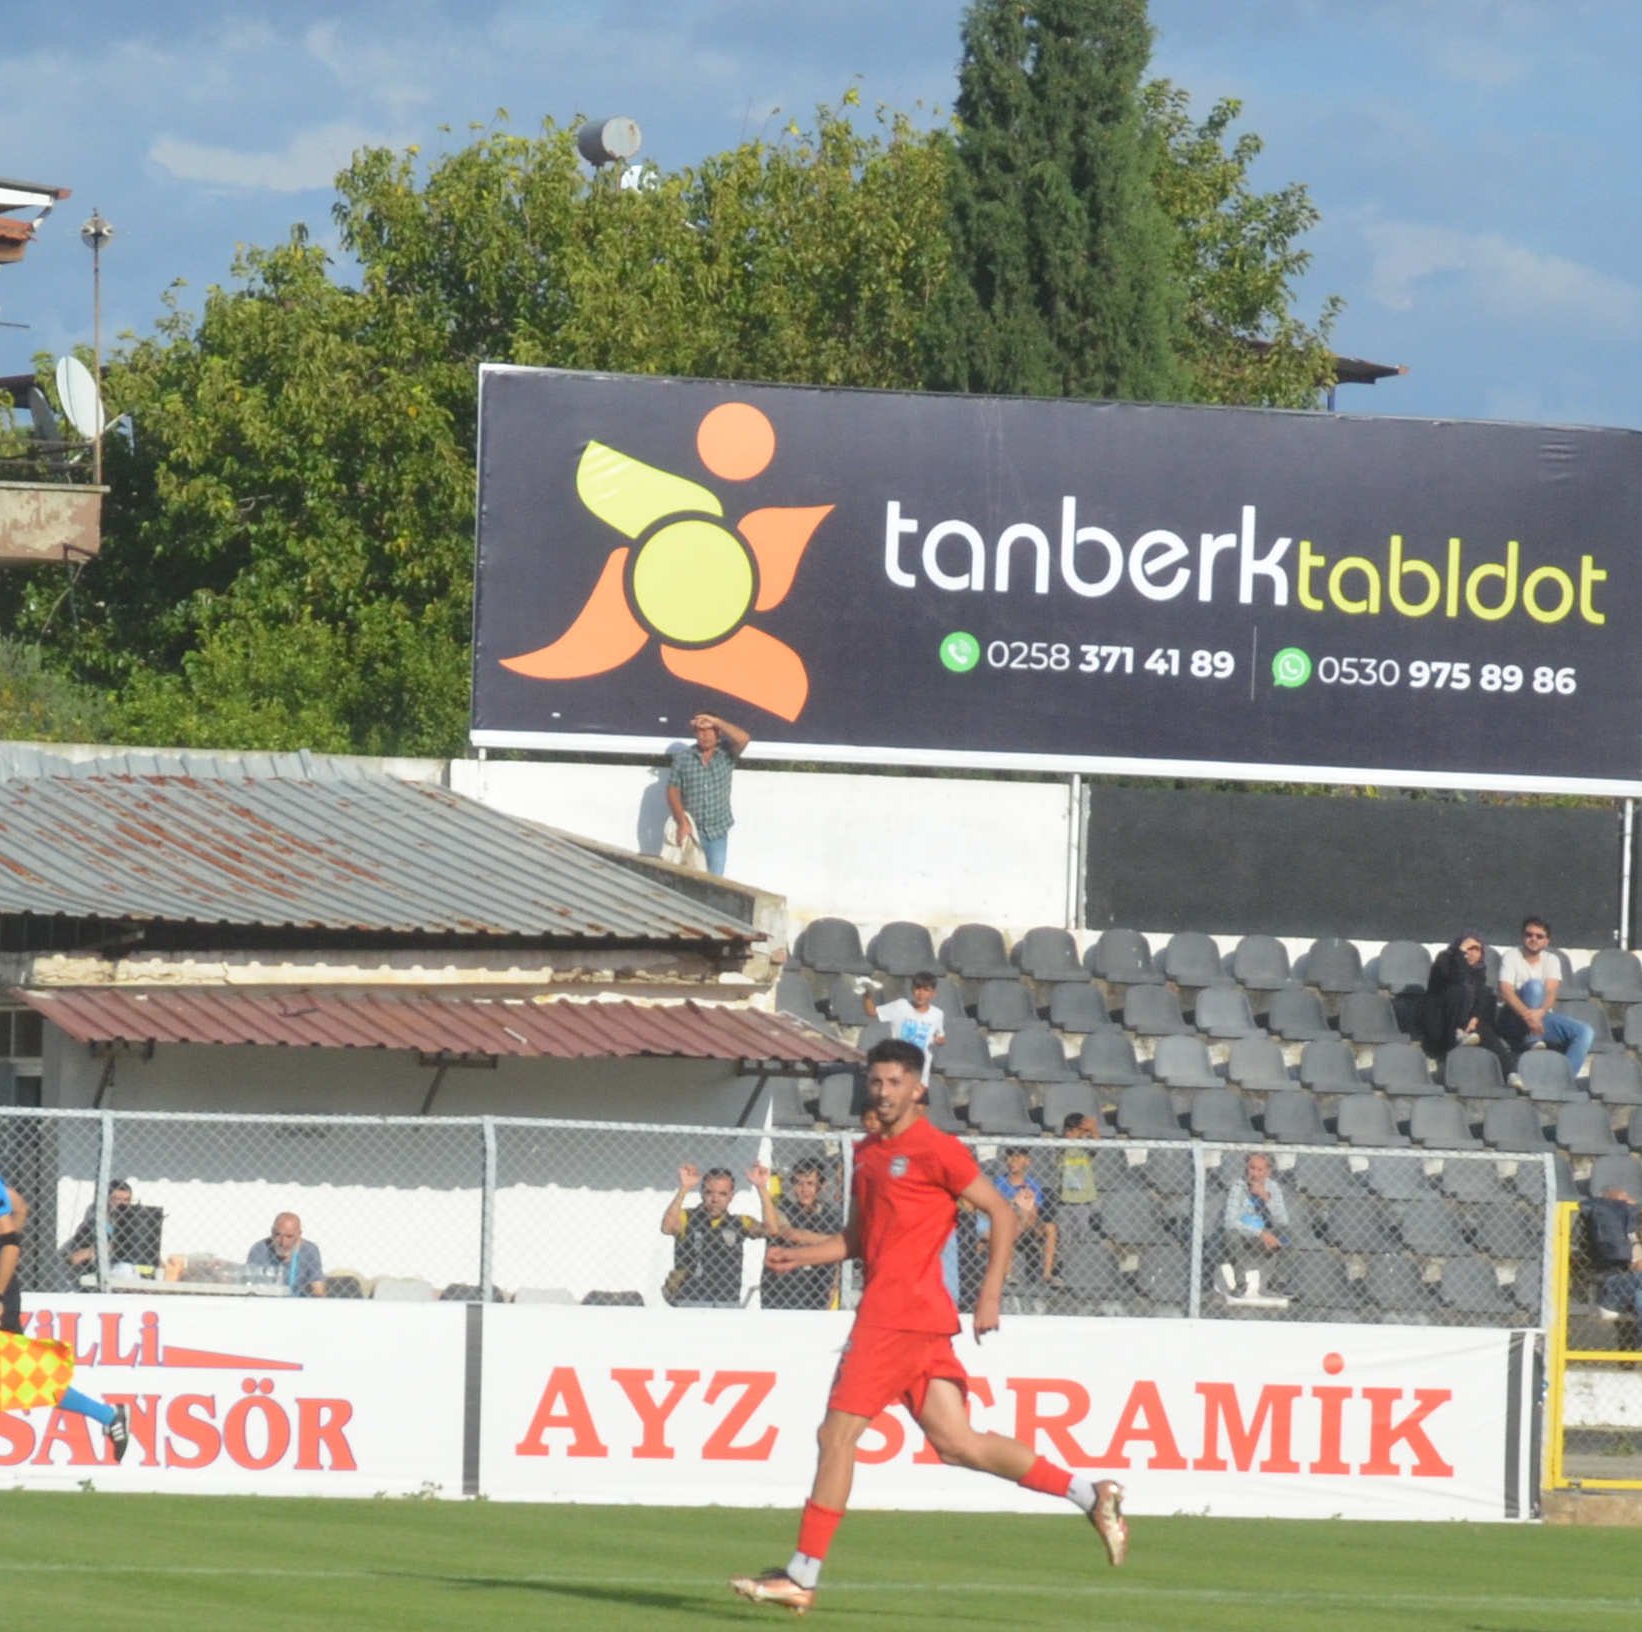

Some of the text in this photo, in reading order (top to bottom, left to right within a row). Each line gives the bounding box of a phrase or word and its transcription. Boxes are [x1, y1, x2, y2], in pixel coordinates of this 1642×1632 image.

[987, 641, 1236, 679] 0258 371 41 89
[1318, 656, 1577, 696] 0530 975 89 86
[516, 1367, 780, 1461] AYZ
